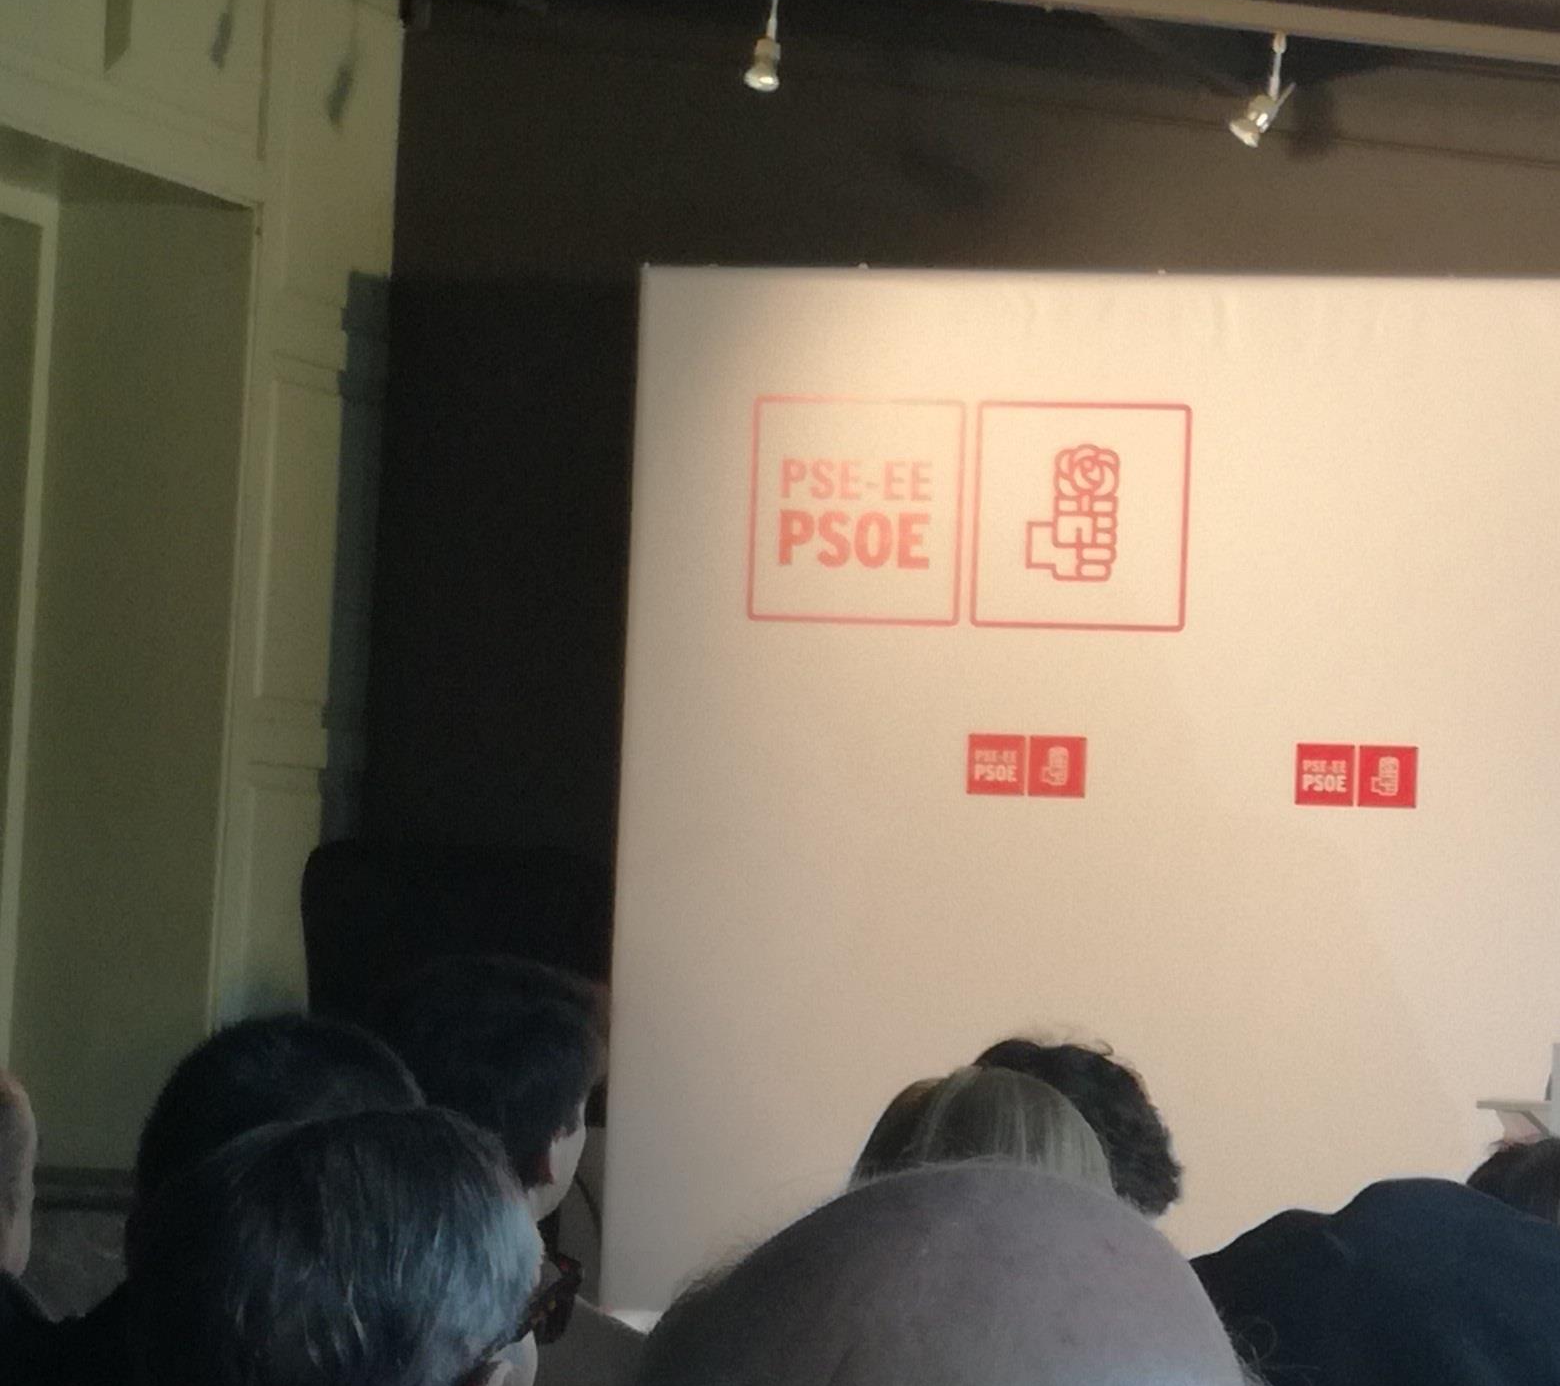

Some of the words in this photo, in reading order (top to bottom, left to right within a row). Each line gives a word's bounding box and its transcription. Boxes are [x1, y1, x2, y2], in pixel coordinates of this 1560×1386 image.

[778, 458, 933, 502] PSE-EE
[777, 508, 931, 570] PSOE
[974, 764, 1018, 782] PSOE
[1302, 774, 1347, 793] PSOE
